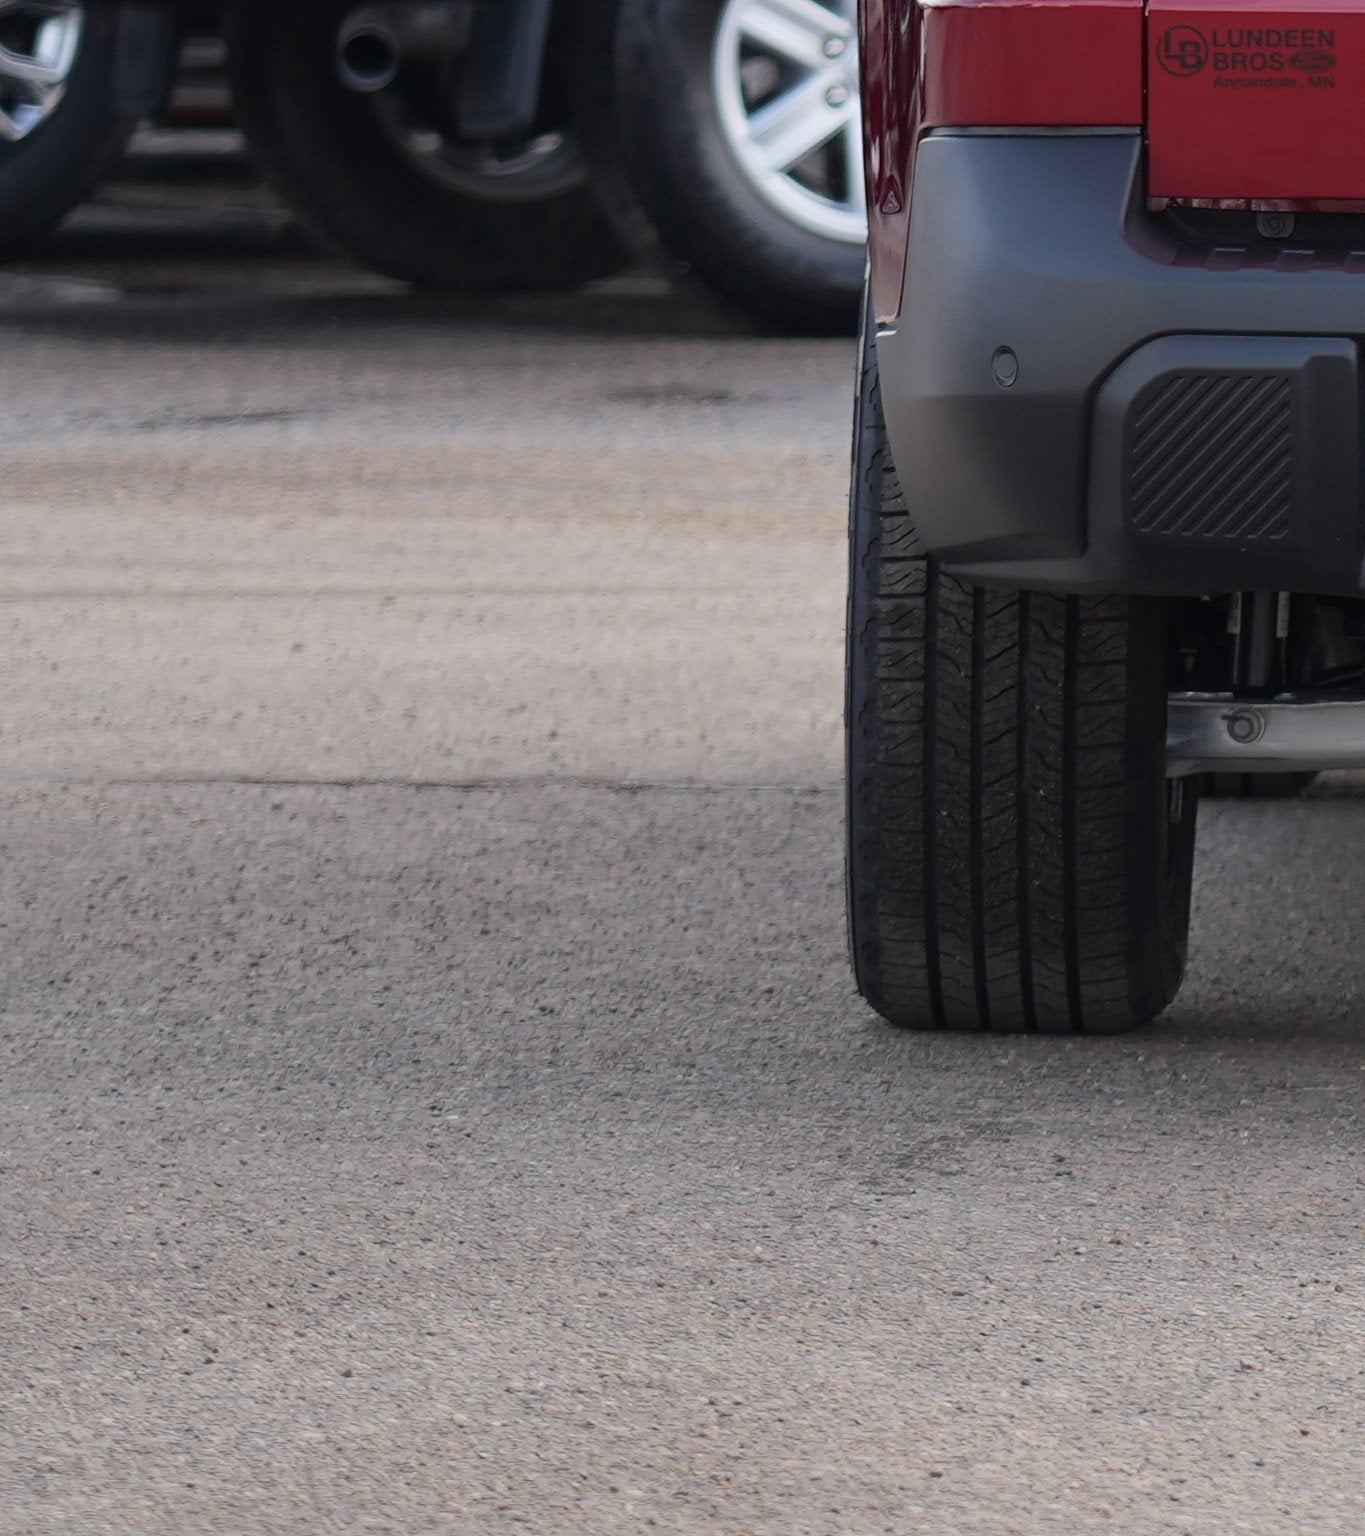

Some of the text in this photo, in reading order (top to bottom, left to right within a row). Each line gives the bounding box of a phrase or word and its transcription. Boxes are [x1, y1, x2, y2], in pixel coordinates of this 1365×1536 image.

[1212, 29, 1336, 48] LUNDEEN
[1213, 52, 1286, 72] BROS
[1309, 76, 1336, 89] MN
